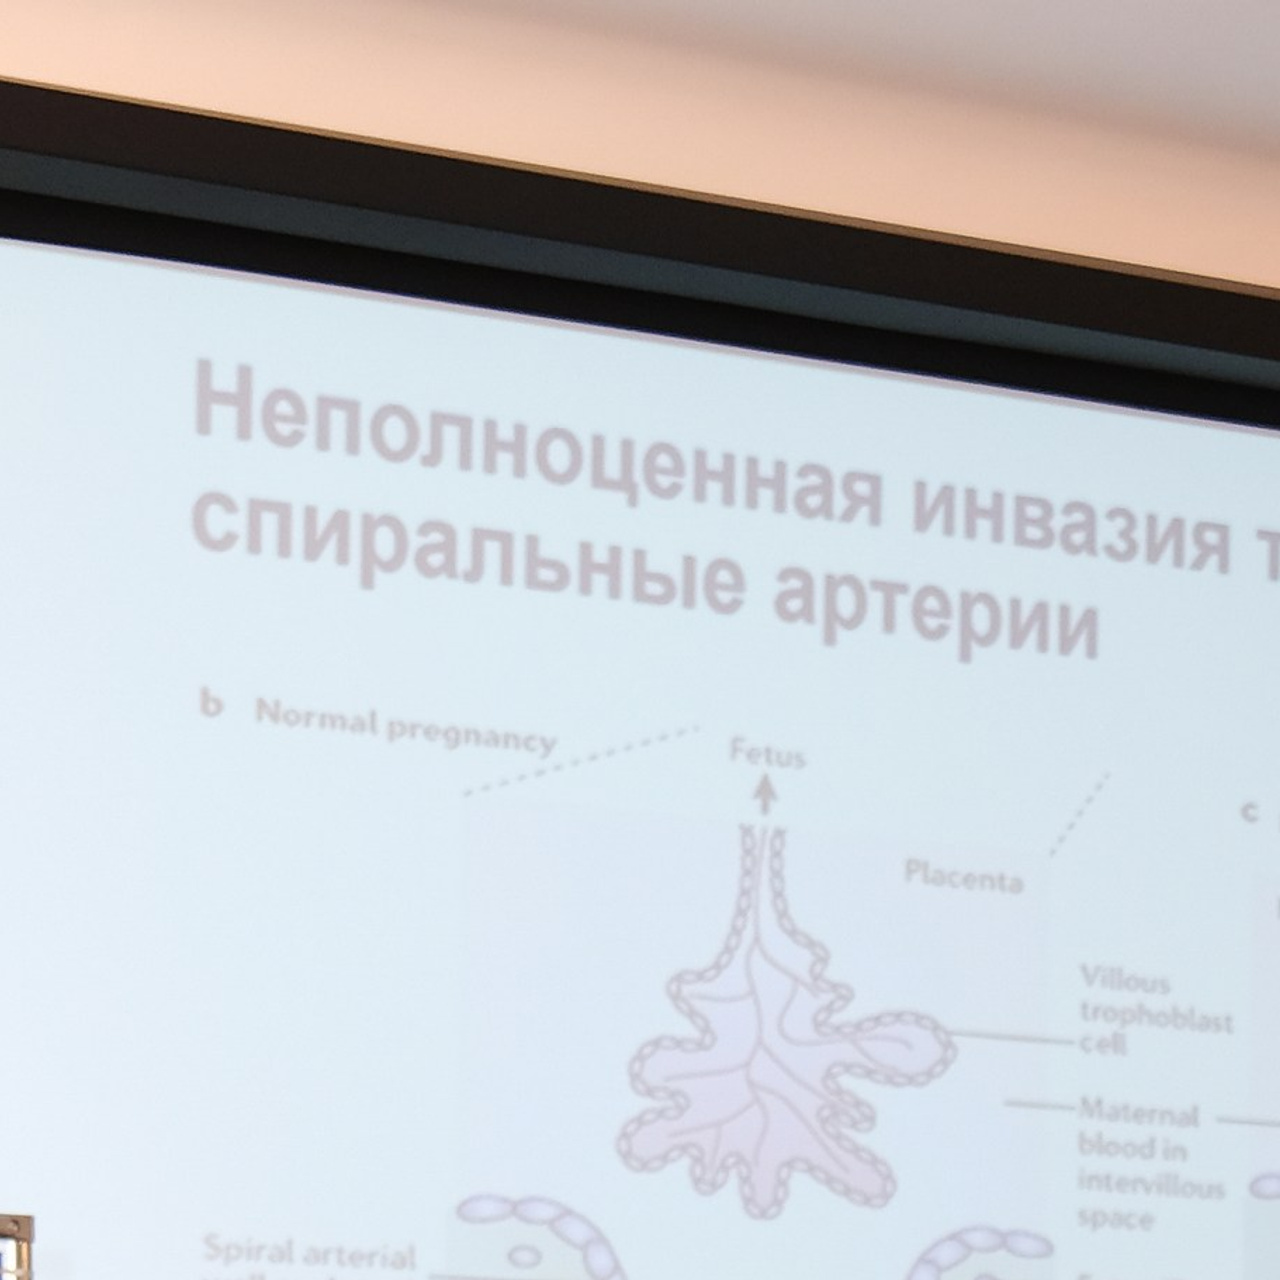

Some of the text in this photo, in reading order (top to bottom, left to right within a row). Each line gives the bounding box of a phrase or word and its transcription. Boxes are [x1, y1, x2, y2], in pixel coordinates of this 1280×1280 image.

[193, 357, 884, 527] Неполноценная
[912, 478, 1232, 576] инвазия
[191, 489, 1102, 662] спиральные артерии
[199, 687, 558, 760] b Normal pregnancy
[728, 736, 808, 772] Fetus
[904, 858, 1025, 895] Placenta
[1079, 963, 1171, 995] Villous
[1079, 1001, 1235, 1035] trophoblast
[1078, 1031, 1128, 1056] cell
[1078, 1095, 1200, 1128] Maternal
[1077, 1131, 1189, 1163] blood in
[1077, 1167, 1226, 1200] intervillous
[1077, 1206, 1155, 1233] space
[202, 1231, 418, 1271] Spiral arterial
